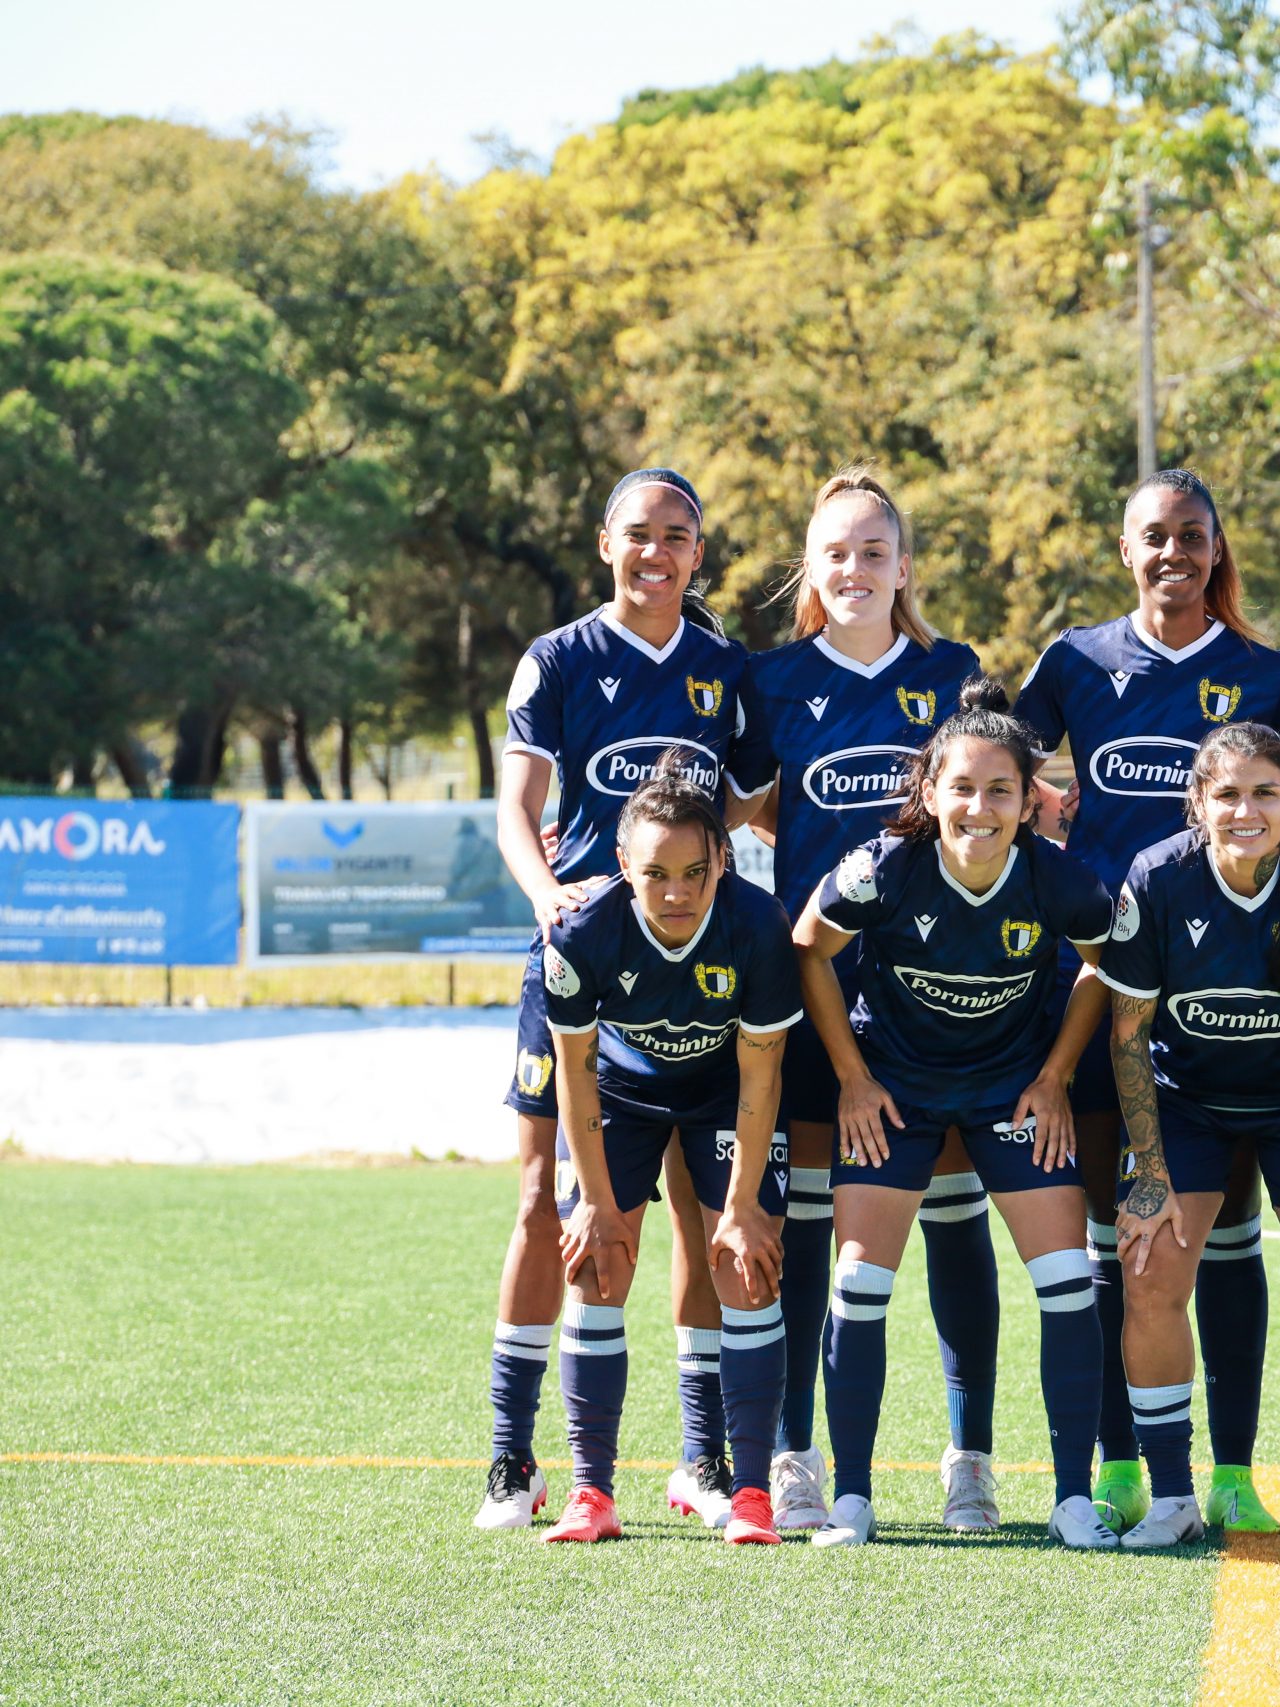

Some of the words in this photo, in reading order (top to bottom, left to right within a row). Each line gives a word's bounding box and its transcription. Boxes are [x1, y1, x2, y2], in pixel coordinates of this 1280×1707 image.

[822, 765, 908, 795] Pormin
[1106, 754, 1194, 786] Pormin
[911, 977, 1027, 1008] Porminho
[627, 1027, 731, 1054] orminho
